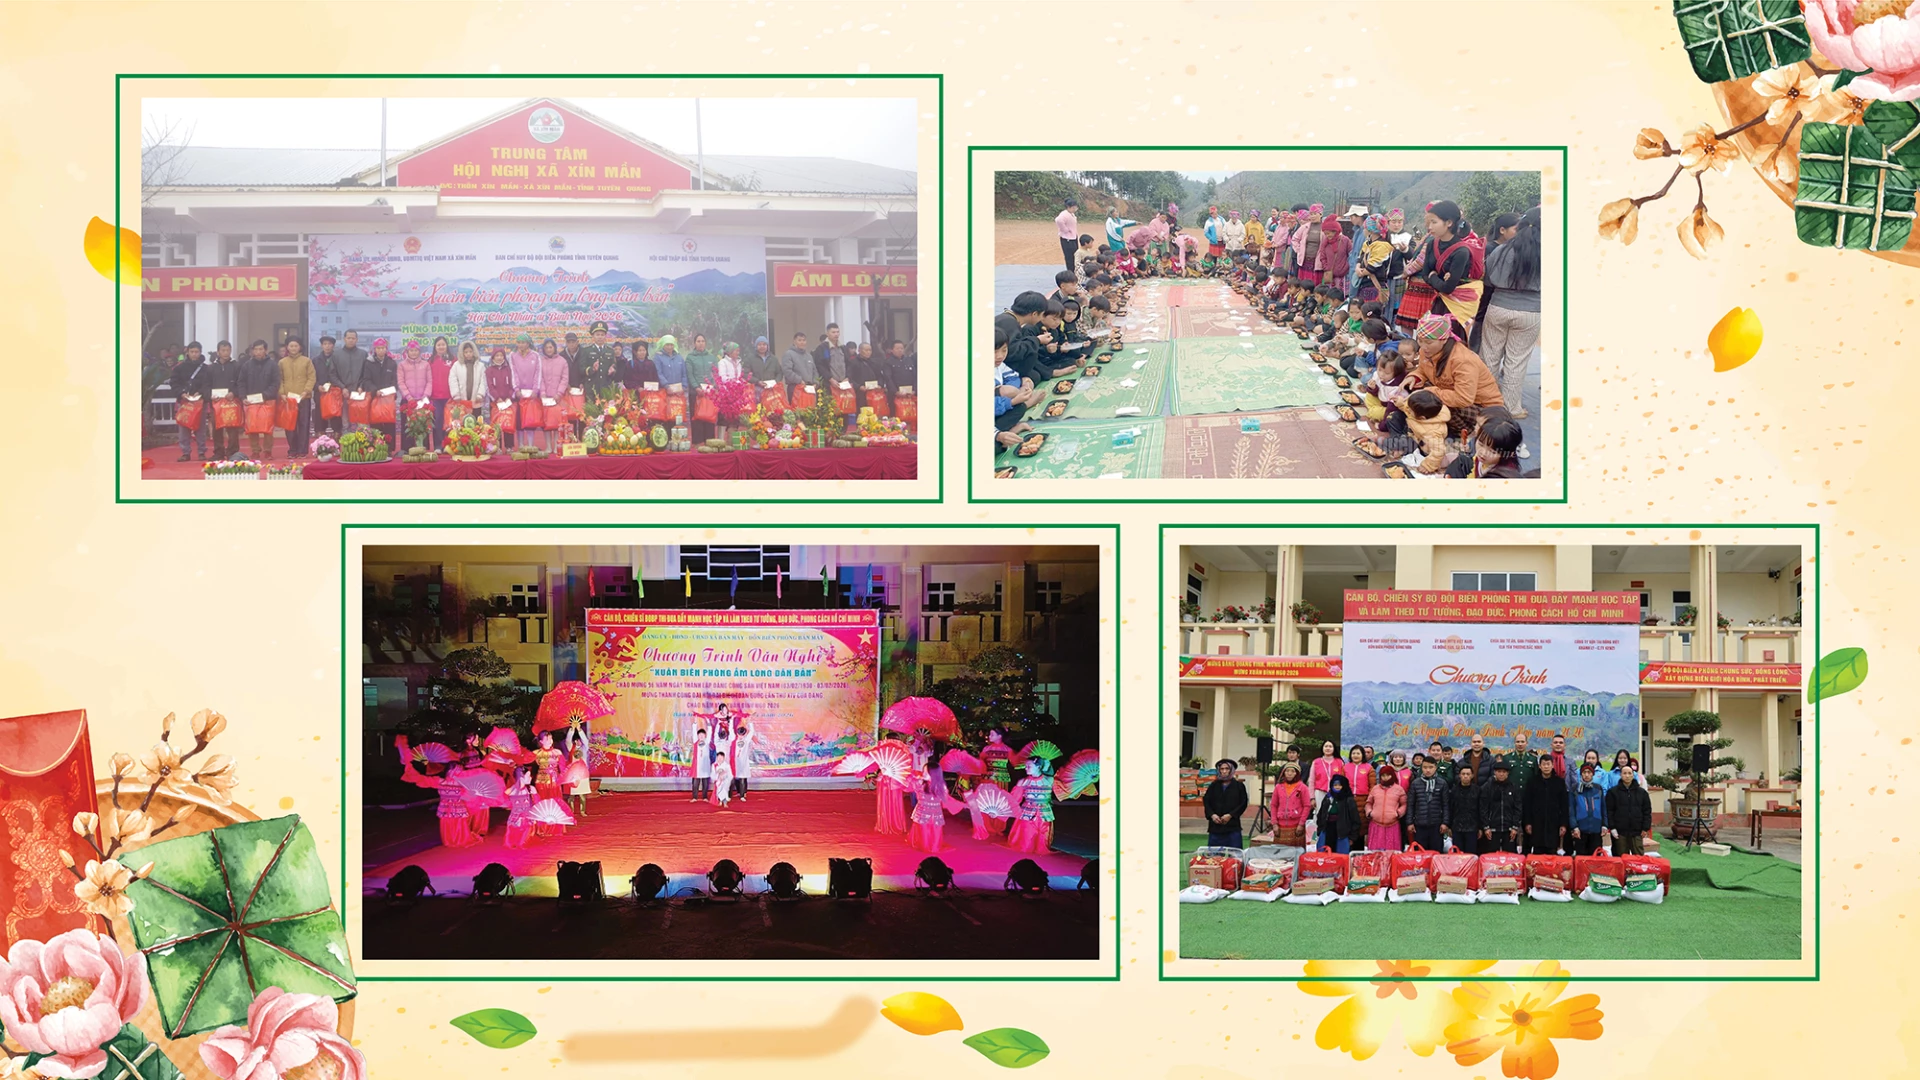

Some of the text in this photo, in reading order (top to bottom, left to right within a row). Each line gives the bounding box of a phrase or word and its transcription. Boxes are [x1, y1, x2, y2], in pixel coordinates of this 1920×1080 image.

[490, 146, 588, 160] TRUNG TÂM
[453, 162, 480, 179] HỘI
[492, 164, 529, 179] NGHỊ
[536, 162, 559, 178] XÃ
[568, 163, 596, 178] XÍN
[172, 273, 280, 292] PHÒNG
[500, 270, 590, 286] Chương Trình
[790, 269, 832, 287] ẤM
[402, 323, 429, 334] MỪNG
[430, 322, 458, 334] ĐẢNG
[1345, 592, 1364, 602] CÁN
[1367, 593, 1380, 604] BỘ,
[1383, 592, 1408, 602] CHIẾN
[1425, 594, 1437, 604] BỘ
[1441, 594, 1455, 604] ĐỘI
[1458, 593, 1478, 603] BIÊN
[1481, 594, 1510, 603] PHÒNG
[1514, 595, 1527, 604] THI
[1530, 595, 1548, 604] ĐUA
[1551, 593, 1568, 604] ĐẨY
[1572, 595, 1598, 605] MẠNH
[1601, 595, 1618, 605] HỌC
[1622, 594, 1638, 605] TẬP
[1358, 605, 1624, 618] VÀ LÀM THEO TƯ TƯỞNG, ĐẠO ĐỨC, PHONG CÁCH HỒ CHÍ MINH
[643, 647, 822, 665] Chương Trình Văn Nghệ
[680, 668, 700, 677] BIÊN
[702, 668, 732, 677] PHÒNG
[734, 667, 748, 677] ẤM
[750, 668, 772, 677] LÒNG
[775, 668, 792, 677] DÂN
[1429, 664, 1548, 691] Chương Trình
[1383, 698, 1594, 716] XUÂN BIÊN PHÒNG ẤM LÒNG DÂN BẢN
